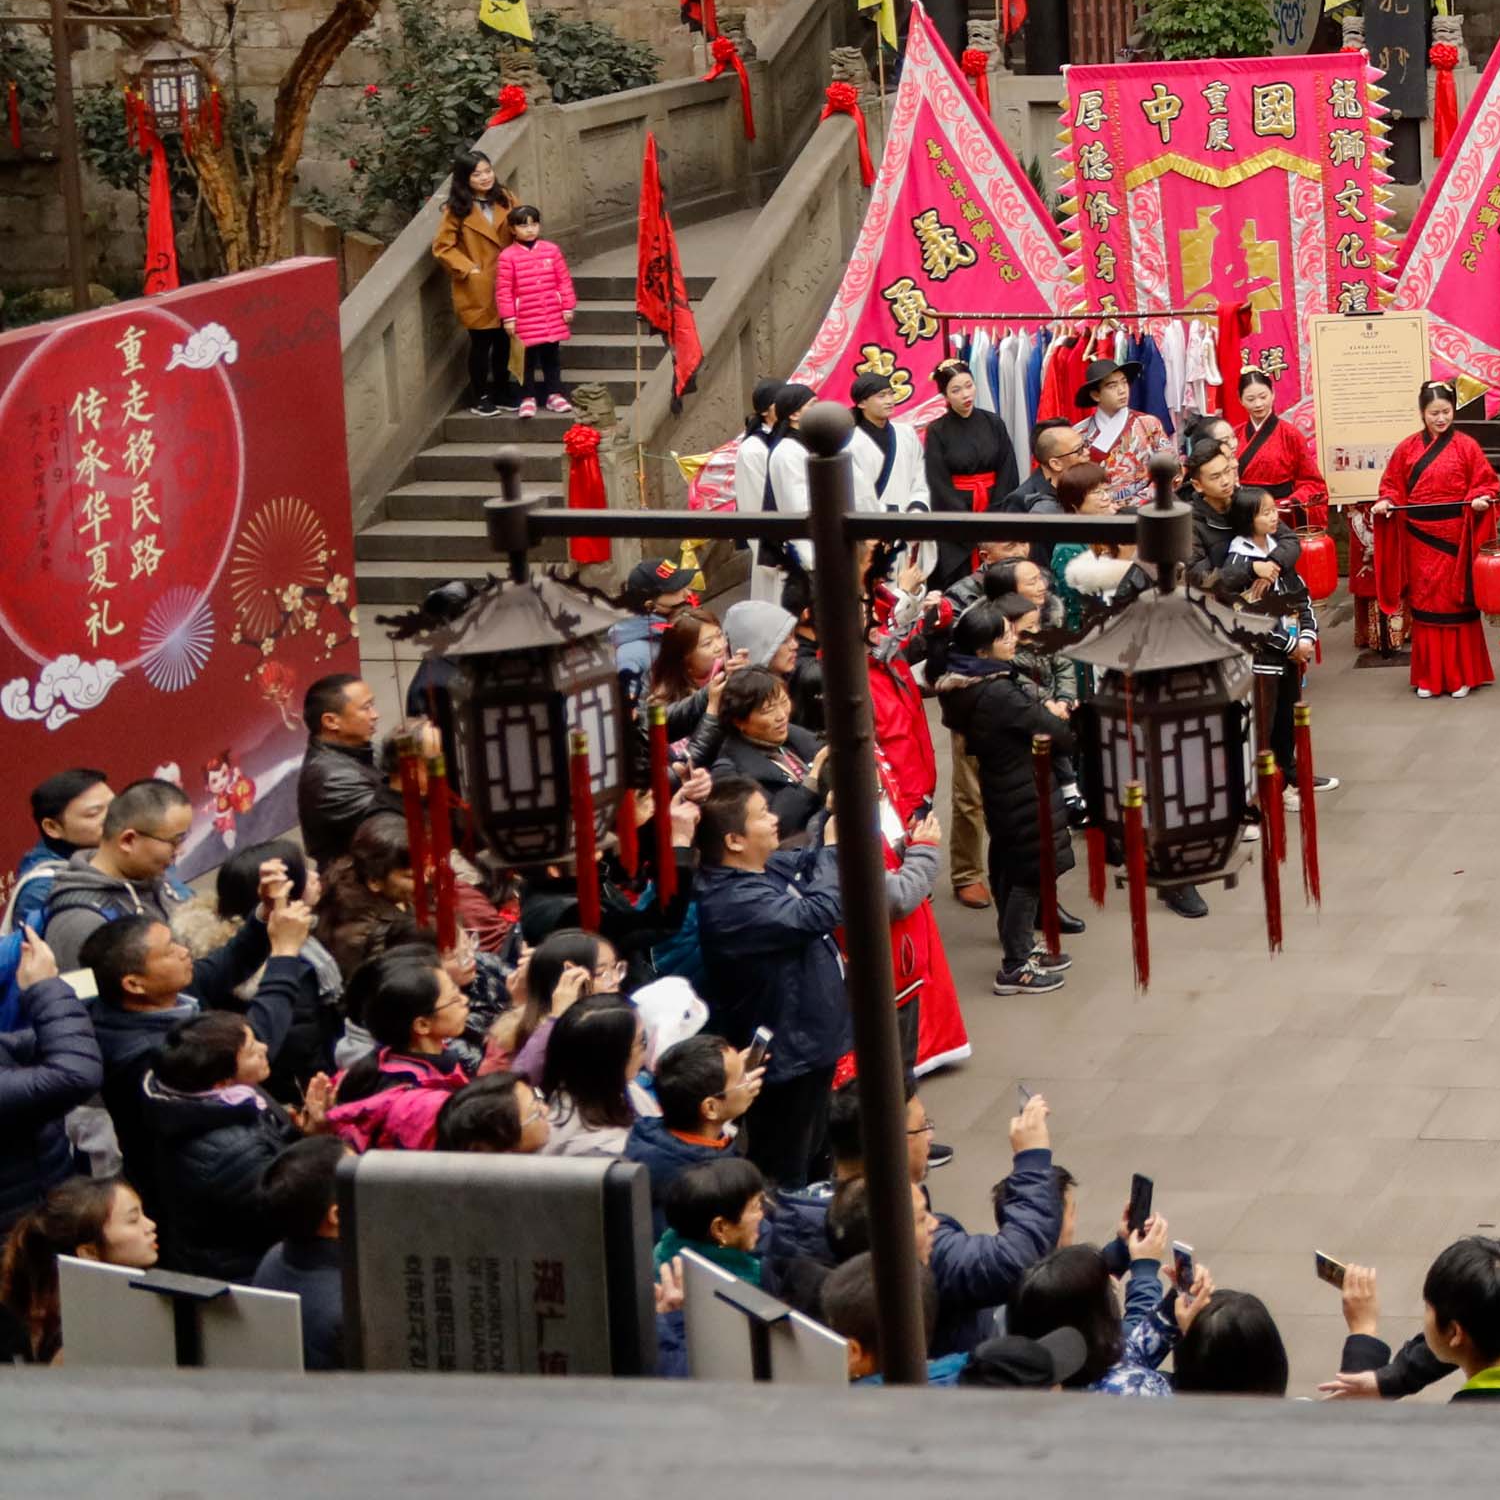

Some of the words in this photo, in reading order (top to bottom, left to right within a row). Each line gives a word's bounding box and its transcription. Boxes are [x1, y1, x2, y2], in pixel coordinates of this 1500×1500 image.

[69, 386, 126, 649] 传承华夏礼
[115, 325, 167, 581] 重走移民路
